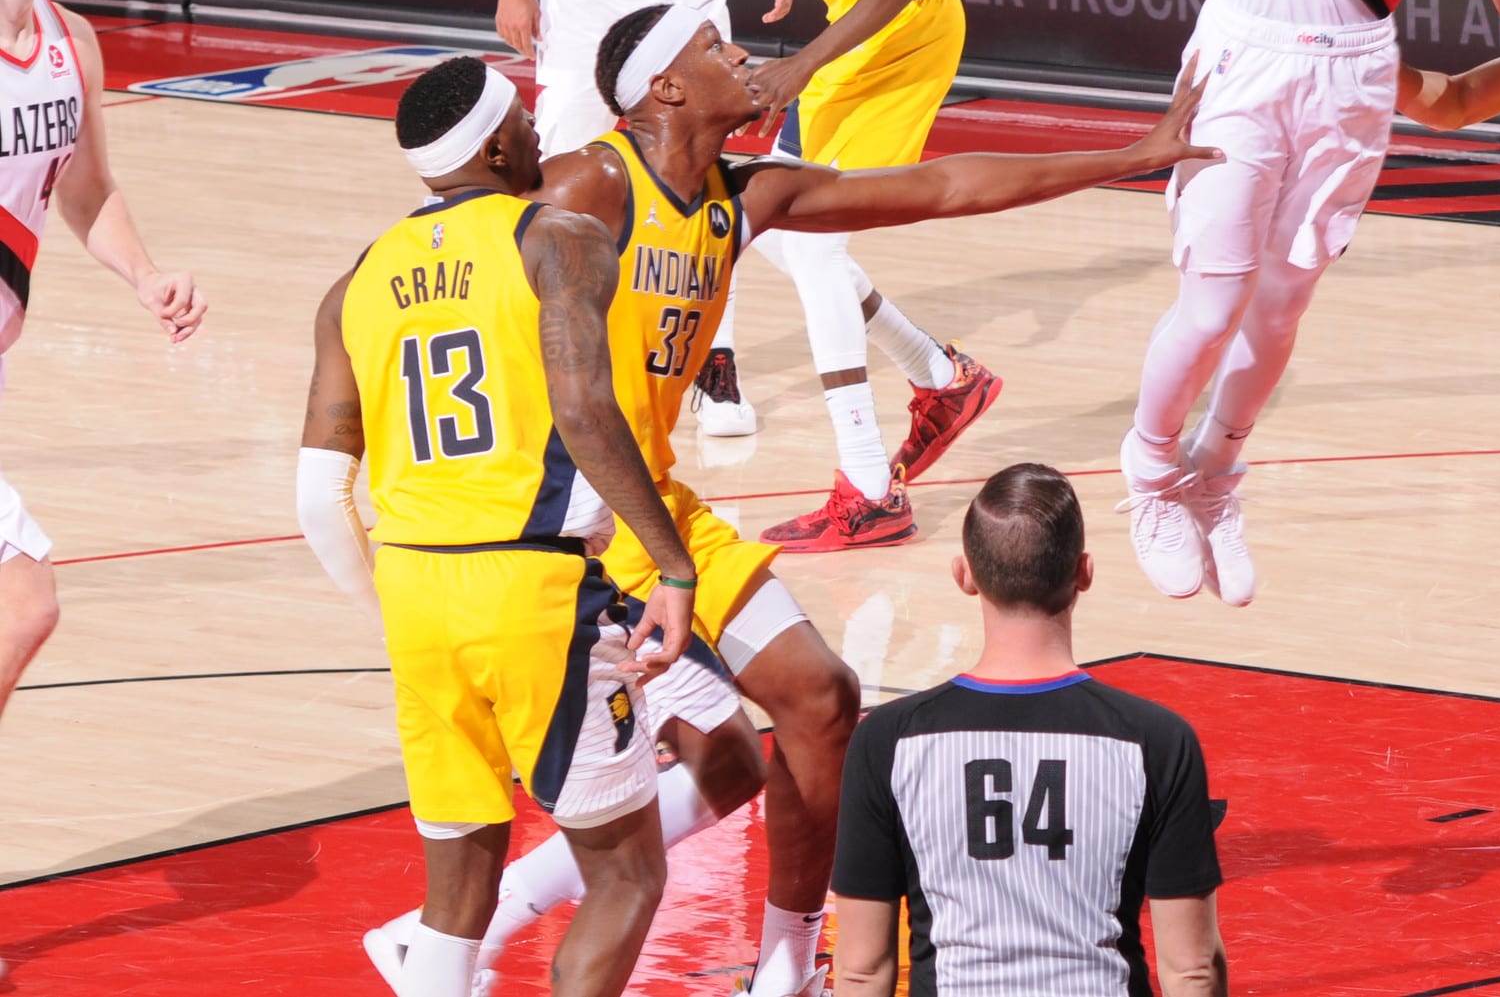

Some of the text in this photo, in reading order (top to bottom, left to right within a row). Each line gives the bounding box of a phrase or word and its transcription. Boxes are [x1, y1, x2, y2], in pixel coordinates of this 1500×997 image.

[1296, 32, 1333, 48] ripcity
[40, 152, 72, 211] 4
[389, 259, 474, 310] CRAIG
[645, 305, 702, 379] 33
[400, 326, 496, 465] 13
[963, 757, 1074, 862] 64
